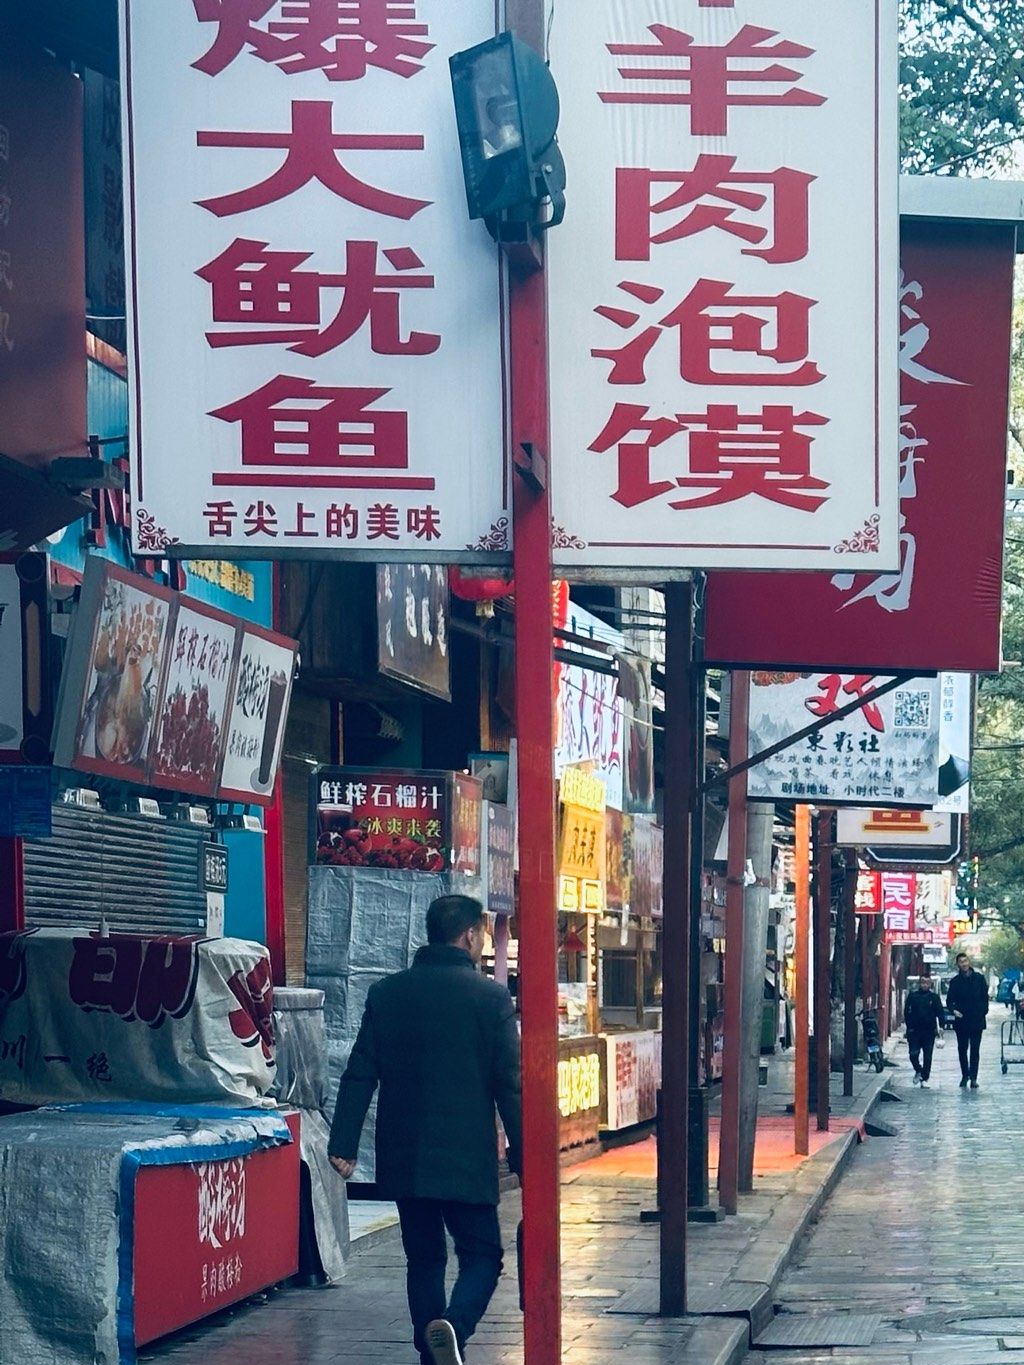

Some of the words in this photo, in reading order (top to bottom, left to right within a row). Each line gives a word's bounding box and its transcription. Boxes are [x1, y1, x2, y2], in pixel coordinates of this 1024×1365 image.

[587, 0, 830, 513] 羊肉泡馍
[202, 501, 442, 541] 舌尖上的美味
[320, 780, 443, 810] 鲜榨石榴汁
[367, 817, 442, 838] 冰爽来袭
